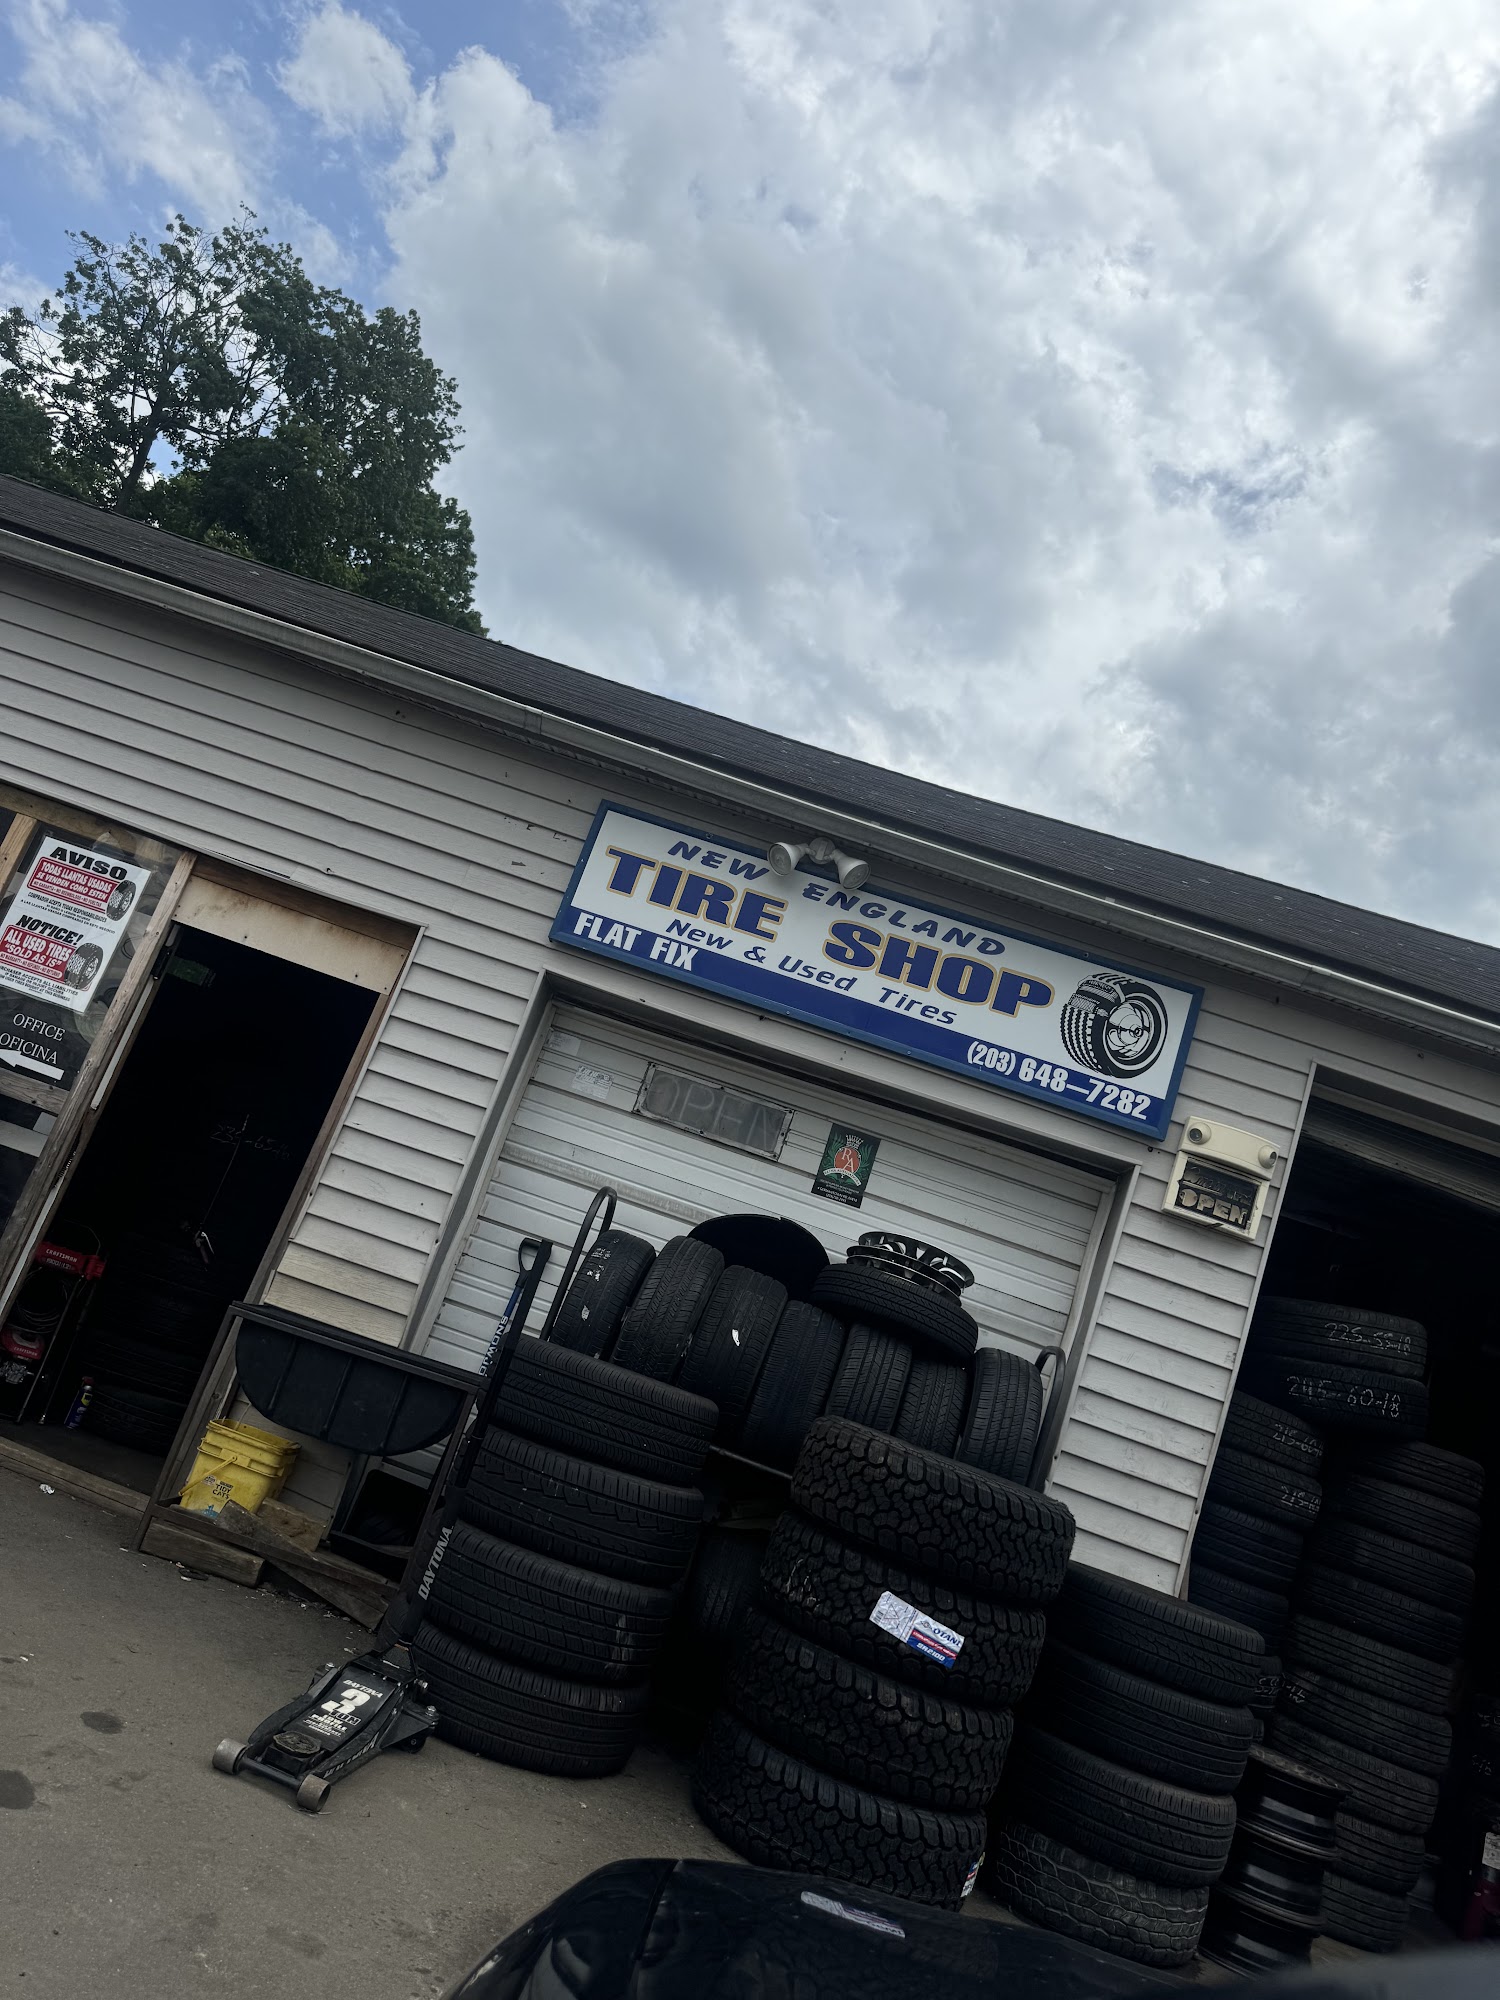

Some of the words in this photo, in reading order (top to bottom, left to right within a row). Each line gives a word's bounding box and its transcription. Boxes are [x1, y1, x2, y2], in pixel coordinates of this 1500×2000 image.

[41, 861, 61, 876] TODAS
[61, 868, 89, 885] LLANTAS
[87, 876, 112, 893] USADAS
[50, 846, 128, 880] AVISO
[36, 872, 46, 880] SE
[45, 873, 69, 888] VENDEN
[69, 881, 89, 894] COMO
[88, 887, 108, 900] ESTEN
[667, 840, 770, 880] NEW
[801, 882, 1006, 956] ENGLAND
[4, 929, 23, 944] ALL
[22, 933, 47, 953] USED
[46, 942, 73, 962] TIRES
[16, 914, 84, 945] NOTICE!
[573, 912, 643, 952] FLAT
[649, 936, 699, 972] FIX
[605, 845, 789, 943] TIRE
[822, 920, 1056, 1019] SHOP
[33, 953, 46, 963] AS
[665, 919, 733, 950] New
[743, 946, 766, 963] &
[778, 955, 858, 992] Used
[878, 986, 958, 1025] Tires
[13, 1013, 66, 1041] OFFICE
[0, 1032, 58, 1064] OFICINA
[967, 1041, 1017, 1076] (203)
[1179, 1188, 1248, 1225] OPEN
[45, 1248, 78, 1263] CRAFTSMAN
[212, 1489, 230, 1499] CATS
[215, 1483, 232, 1494] TIDY
[417, 1525, 453, 1600] DAYTONA
[933, 1628, 961, 1646] OTANI
[321, 1688, 371, 1714] 3
[343, 1679, 384, 1698] DAYTONA
